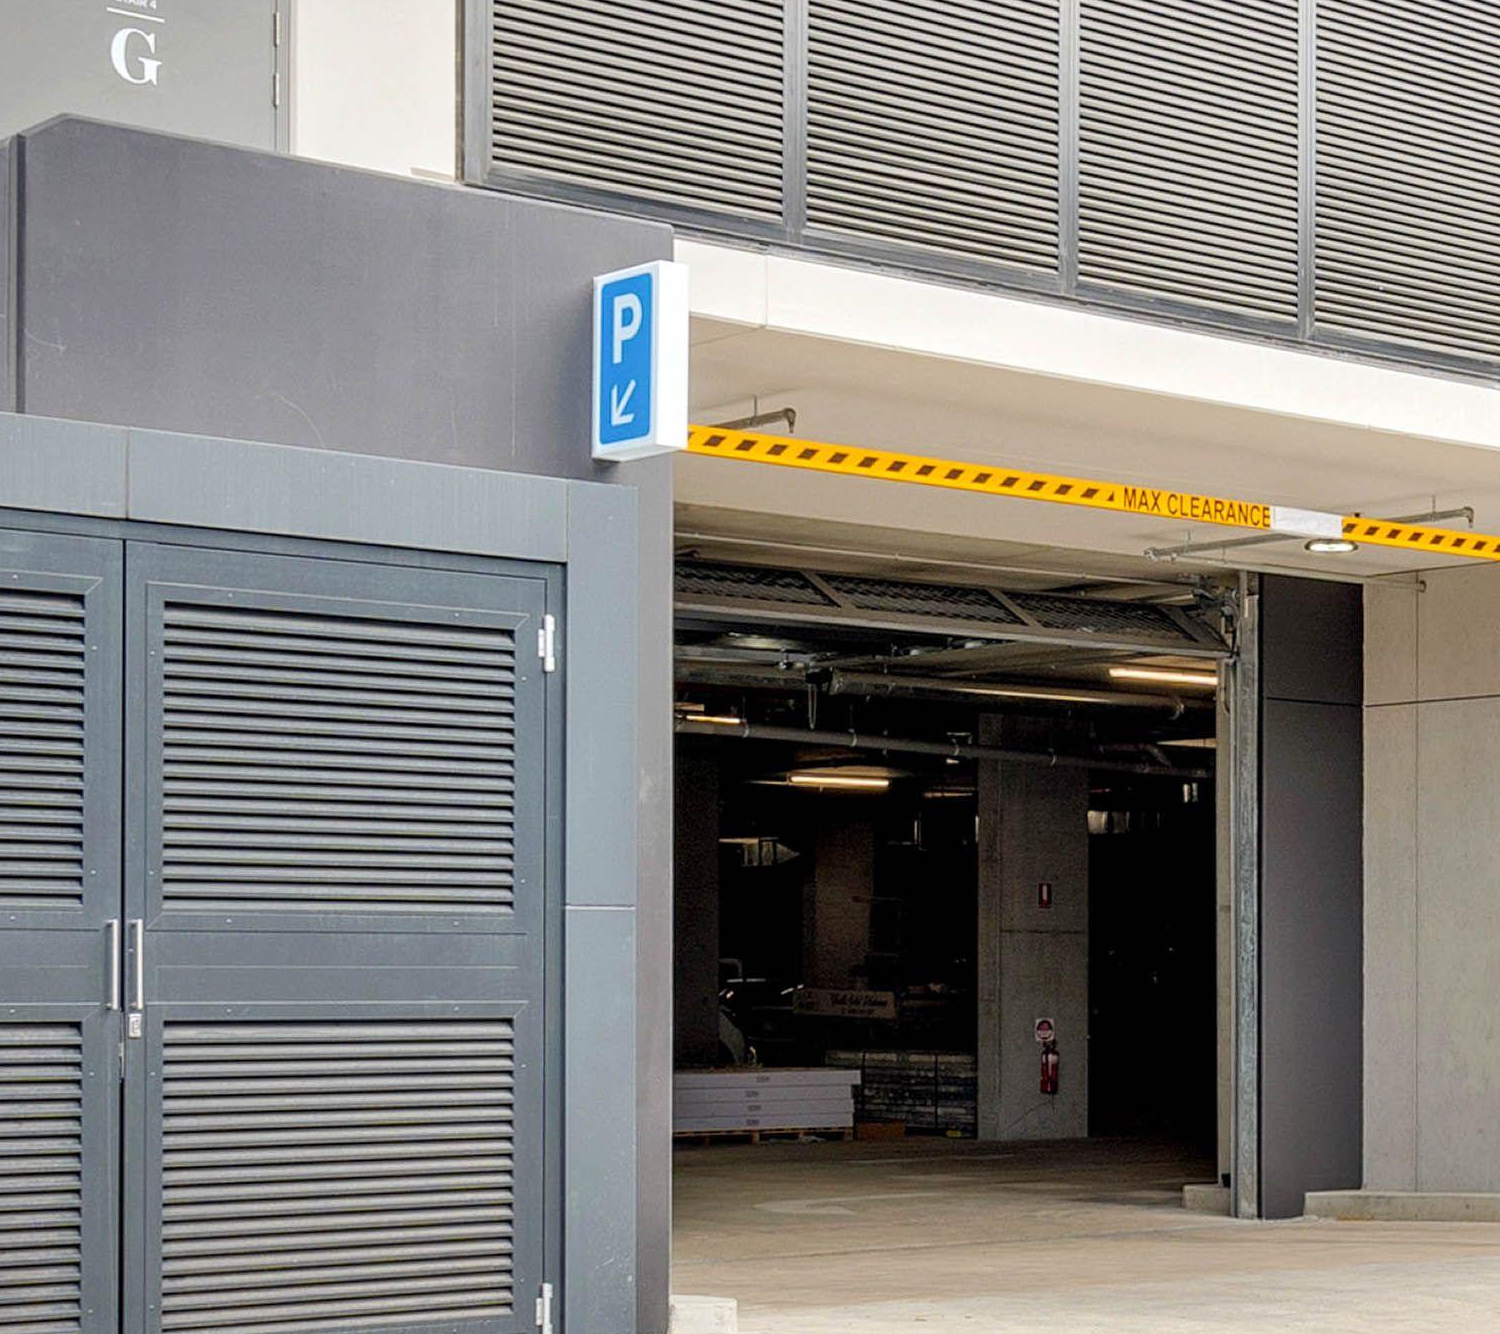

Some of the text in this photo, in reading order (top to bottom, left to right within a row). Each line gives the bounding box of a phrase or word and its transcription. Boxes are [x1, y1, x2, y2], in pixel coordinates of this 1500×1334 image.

[150, 0, 157, 9] 4
[111, 28, 163, 86] G
[613, 293, 643, 364] P
[1123, 487, 1271, 528] MAX CLEARANCE
